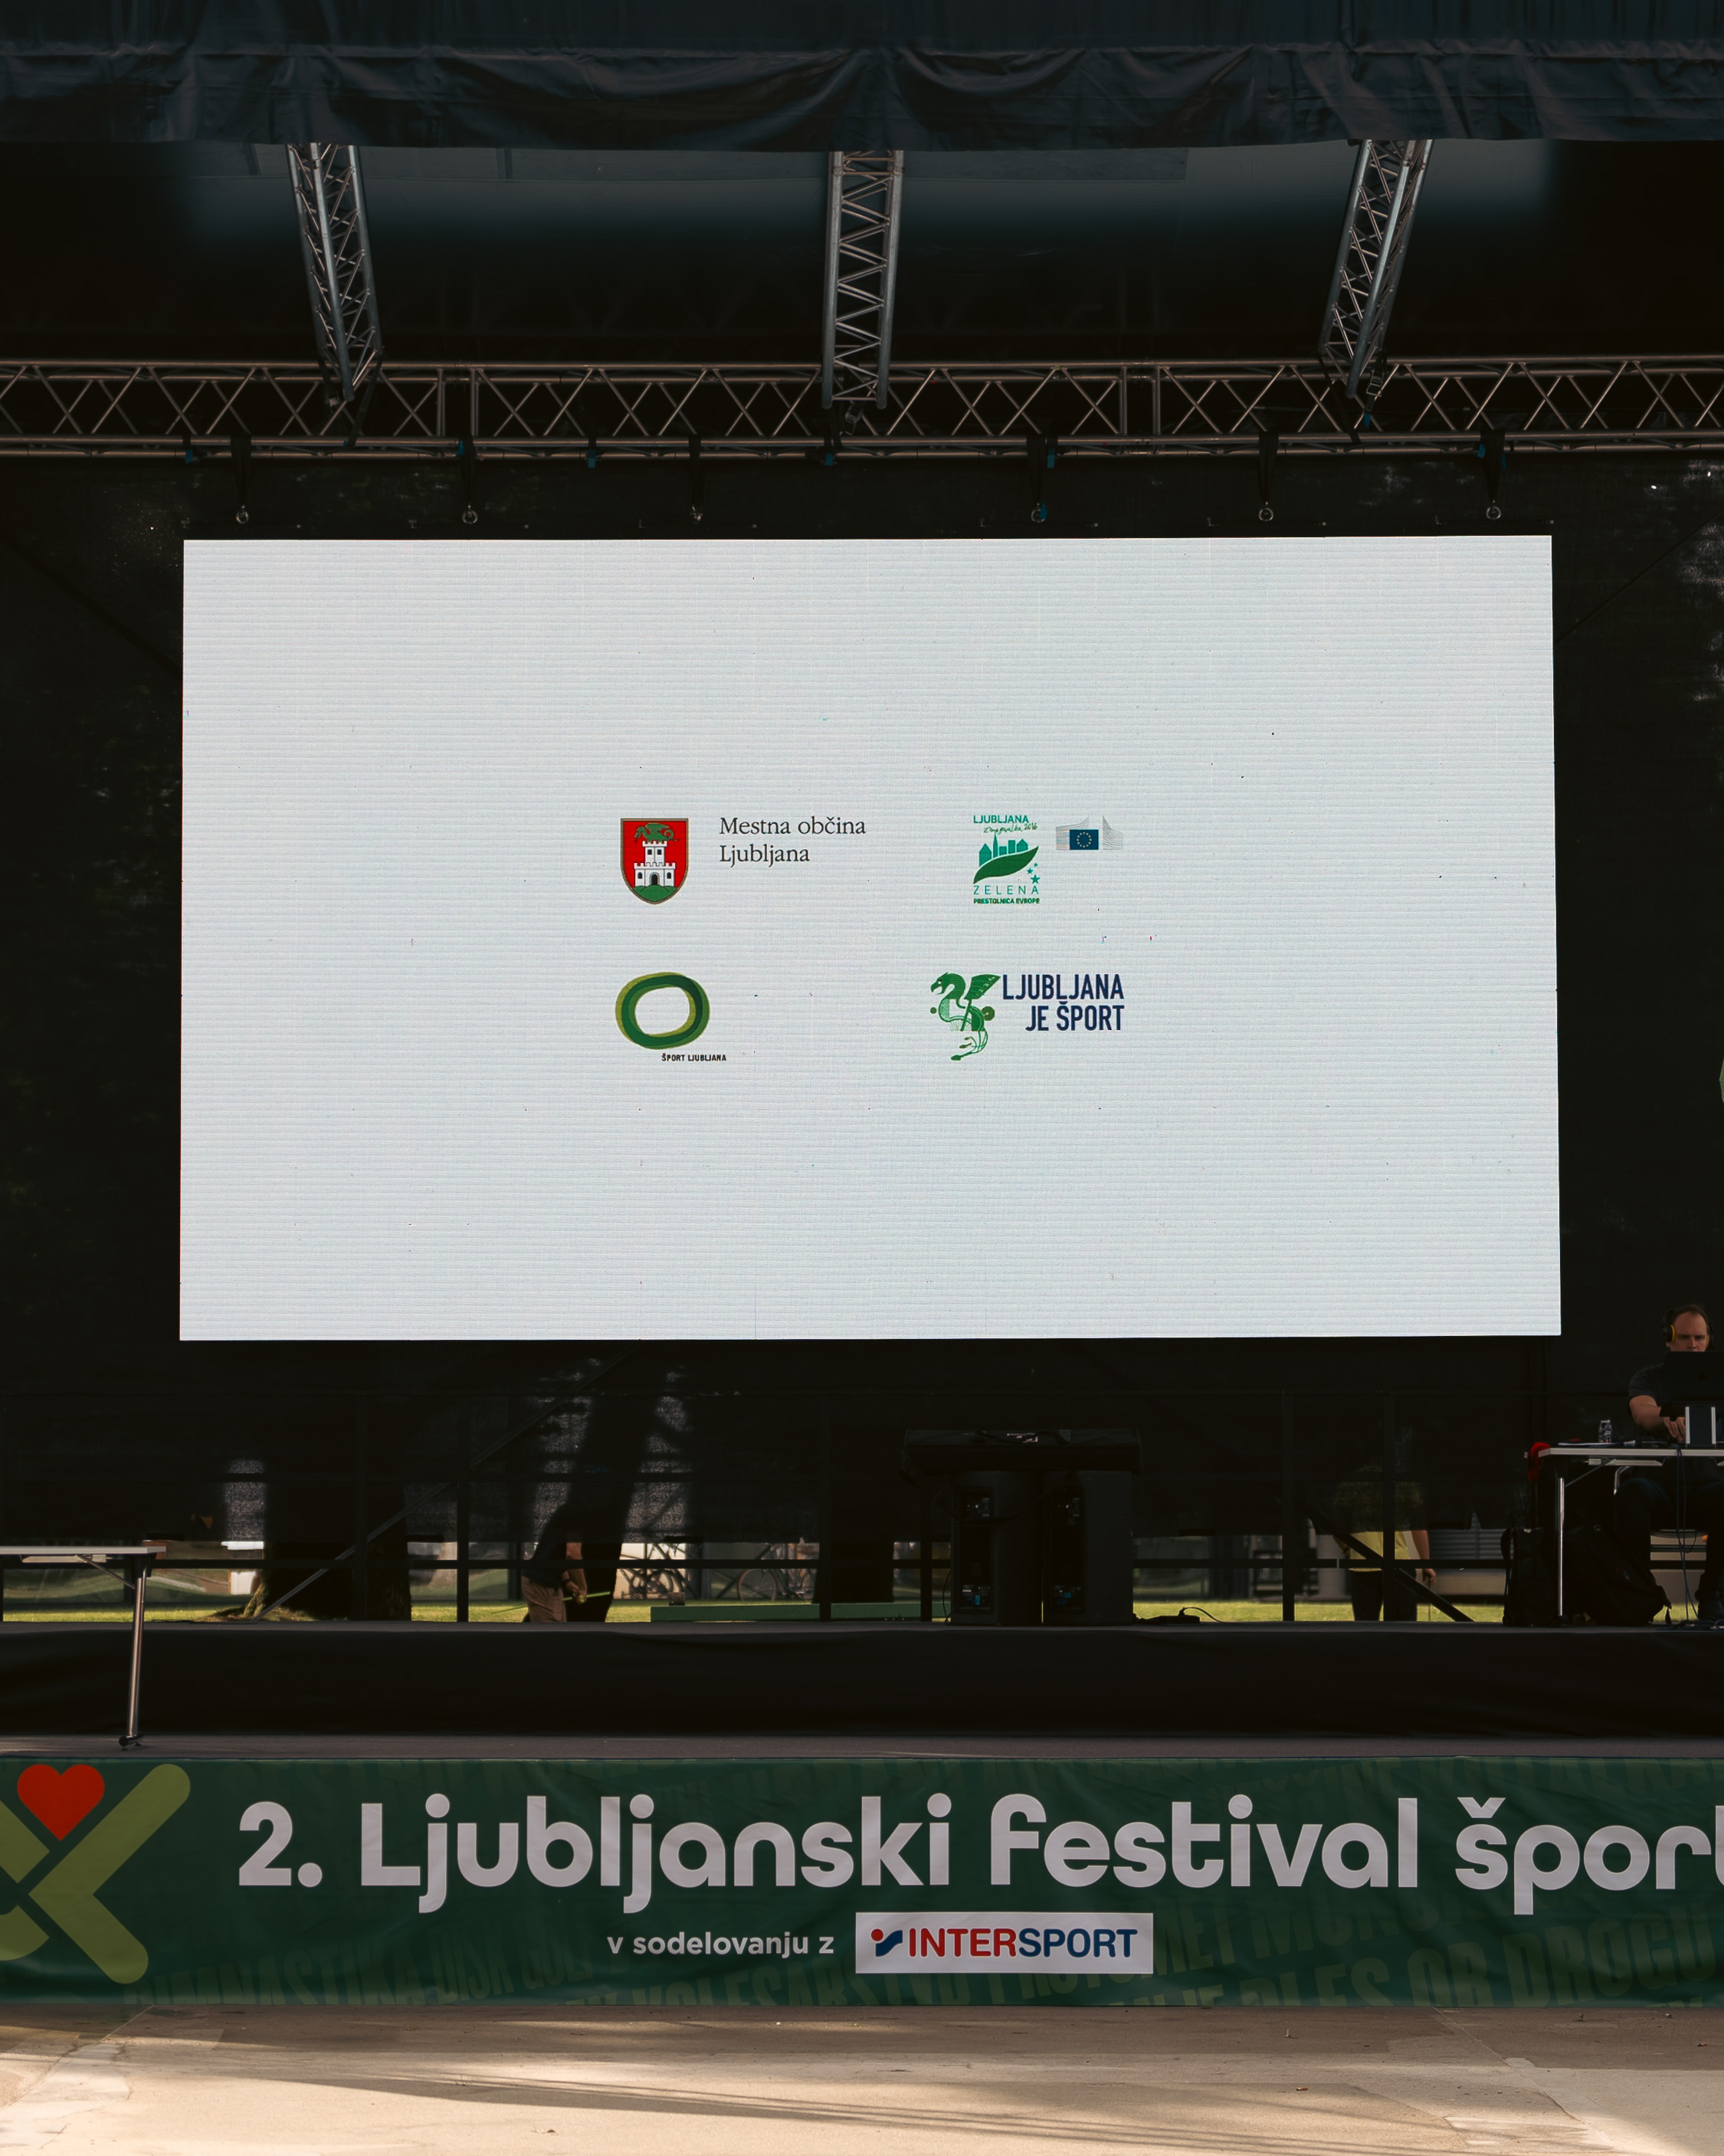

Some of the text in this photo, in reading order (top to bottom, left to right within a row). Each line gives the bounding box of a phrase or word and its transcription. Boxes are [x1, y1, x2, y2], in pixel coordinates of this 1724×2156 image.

[719, 815, 867, 835] Mestna občina
[973, 814, 1029, 824] LJUBLJANA
[719, 843, 810, 868] Ljubljana
[973, 884, 1039, 895] ZELENA
[1002, 973, 1125, 1000] LJUBLJANA
[1024, 1000, 1125, 1032] JE ŠPORT
[661, 1052, 727, 1062] ŠPORT LJUBLJANA
[238, 1793, 1724, 1915] 2. Ljubljanski festival špor
[607, 1931, 834, 1959] v sodelovanju z
[909, 1928, 1139, 1958] INTERSPORT
